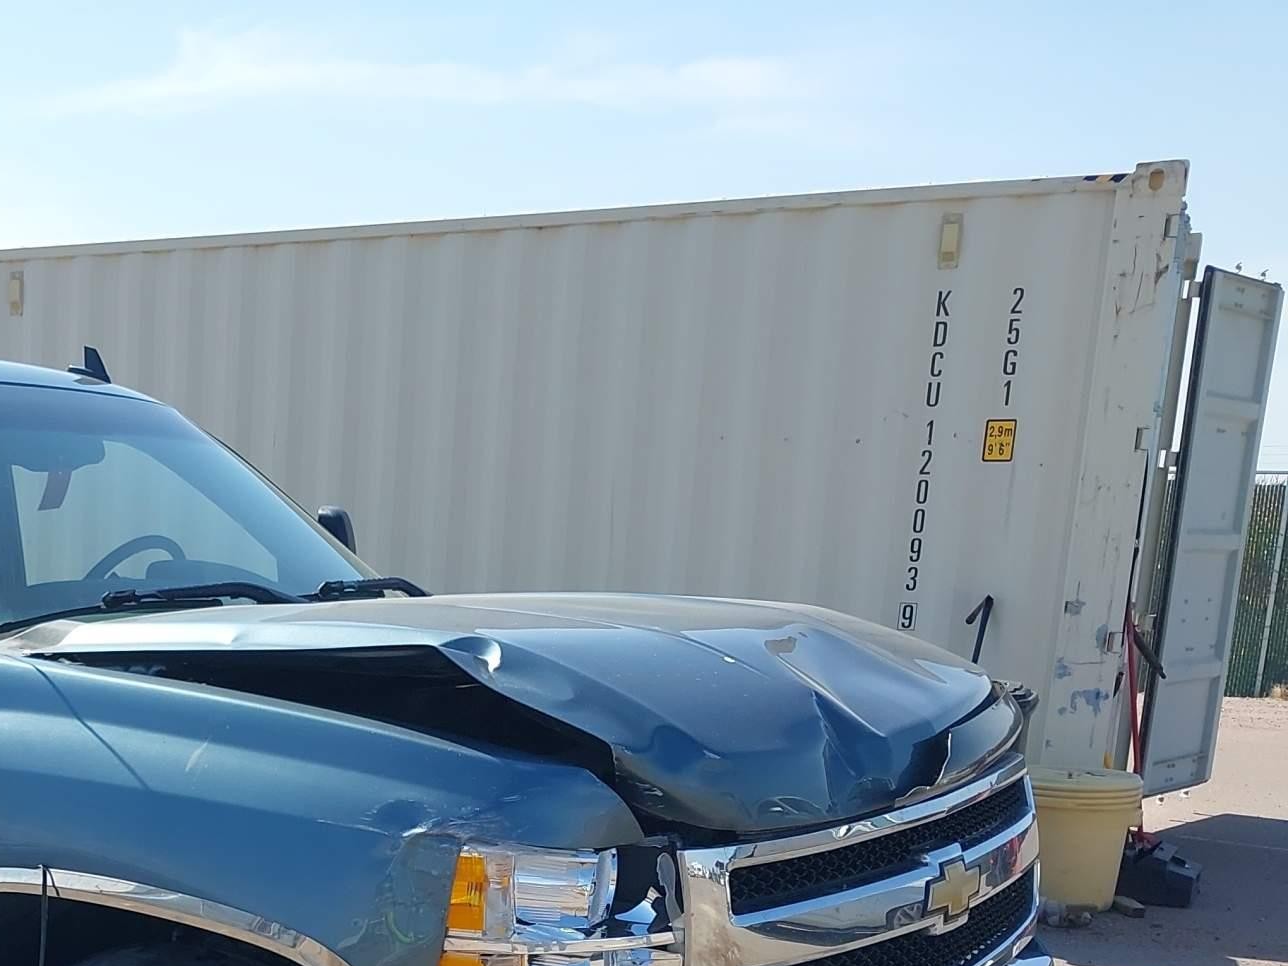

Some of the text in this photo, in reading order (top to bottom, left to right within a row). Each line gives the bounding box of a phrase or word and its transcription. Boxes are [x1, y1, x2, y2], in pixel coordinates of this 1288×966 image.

[900, 290, 953, 630] KDCU 120093 9
[1002, 287, 1025, 407] 25G1
